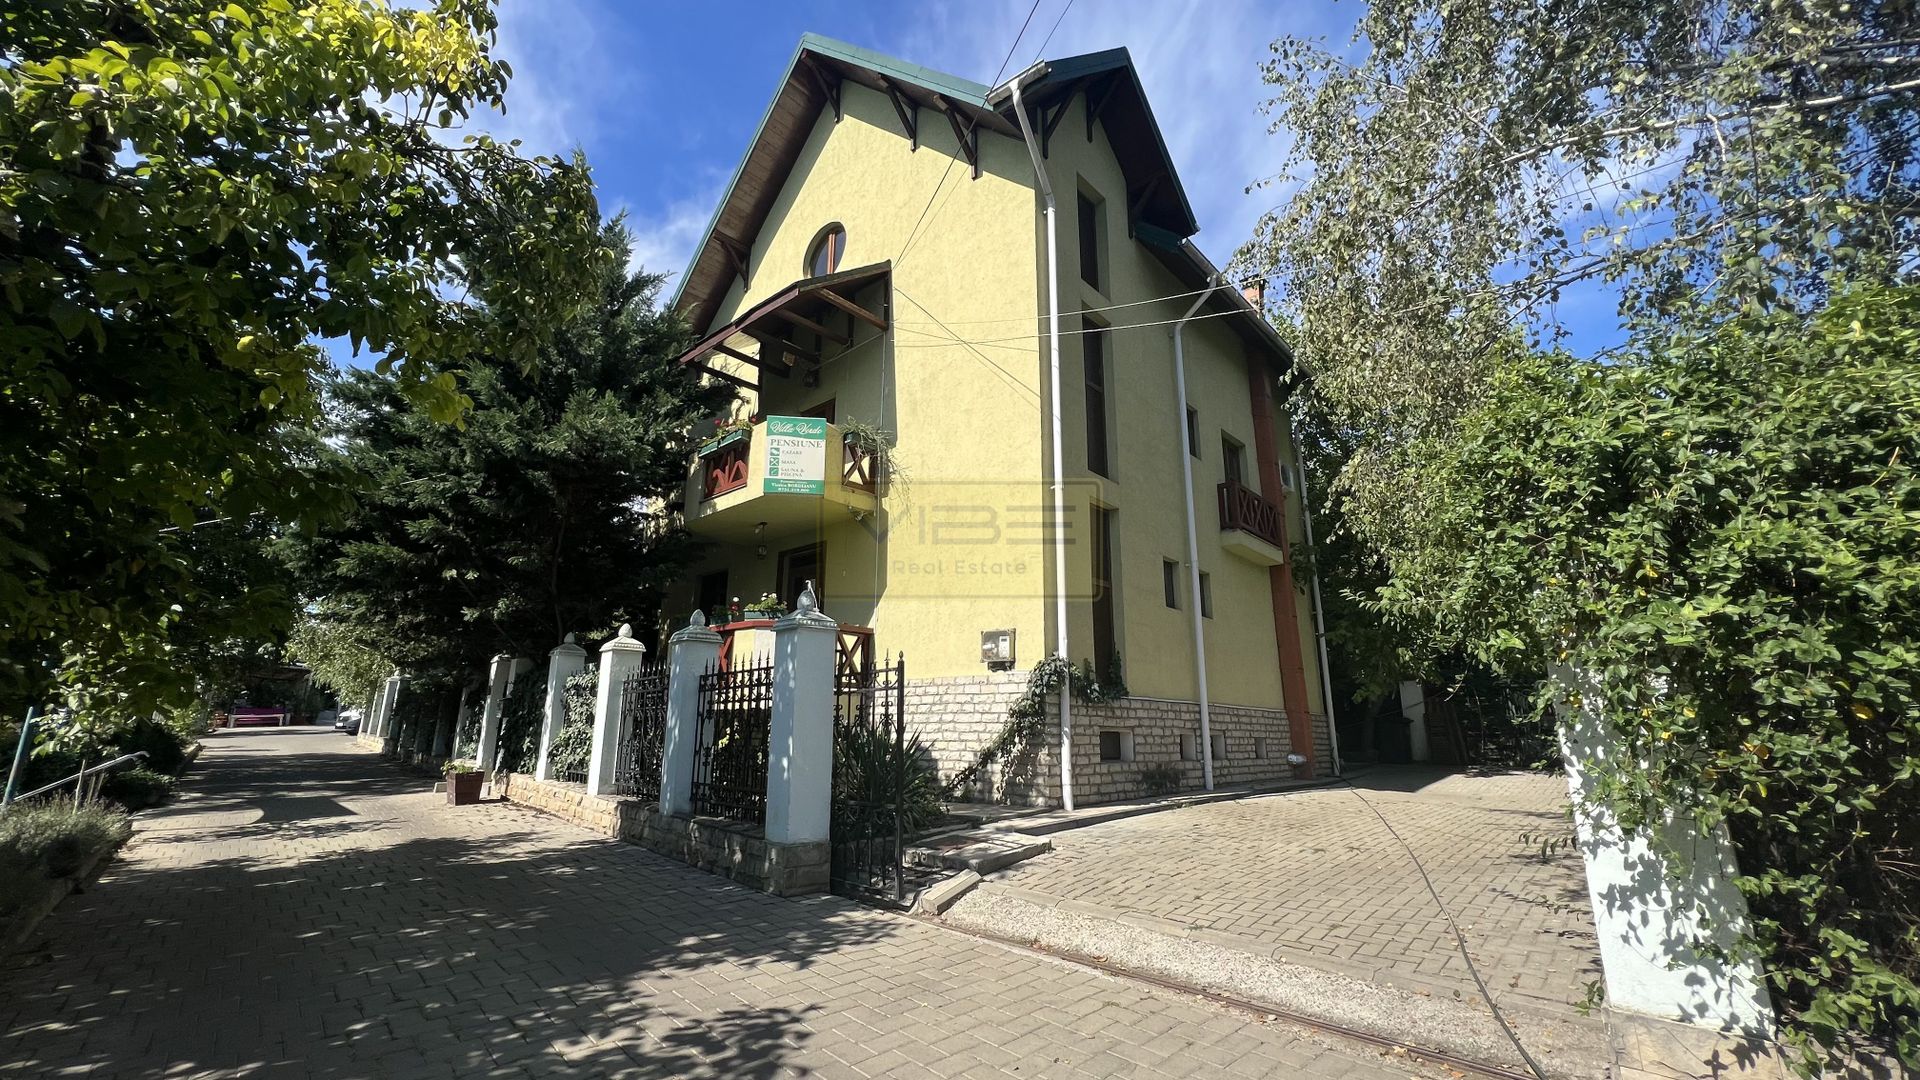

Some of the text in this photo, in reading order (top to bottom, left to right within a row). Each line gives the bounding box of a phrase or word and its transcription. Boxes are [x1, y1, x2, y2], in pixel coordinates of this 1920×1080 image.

[769, 420, 823, 435] Villa Verde
[770, 438, 823, 448] PENSIUNE
